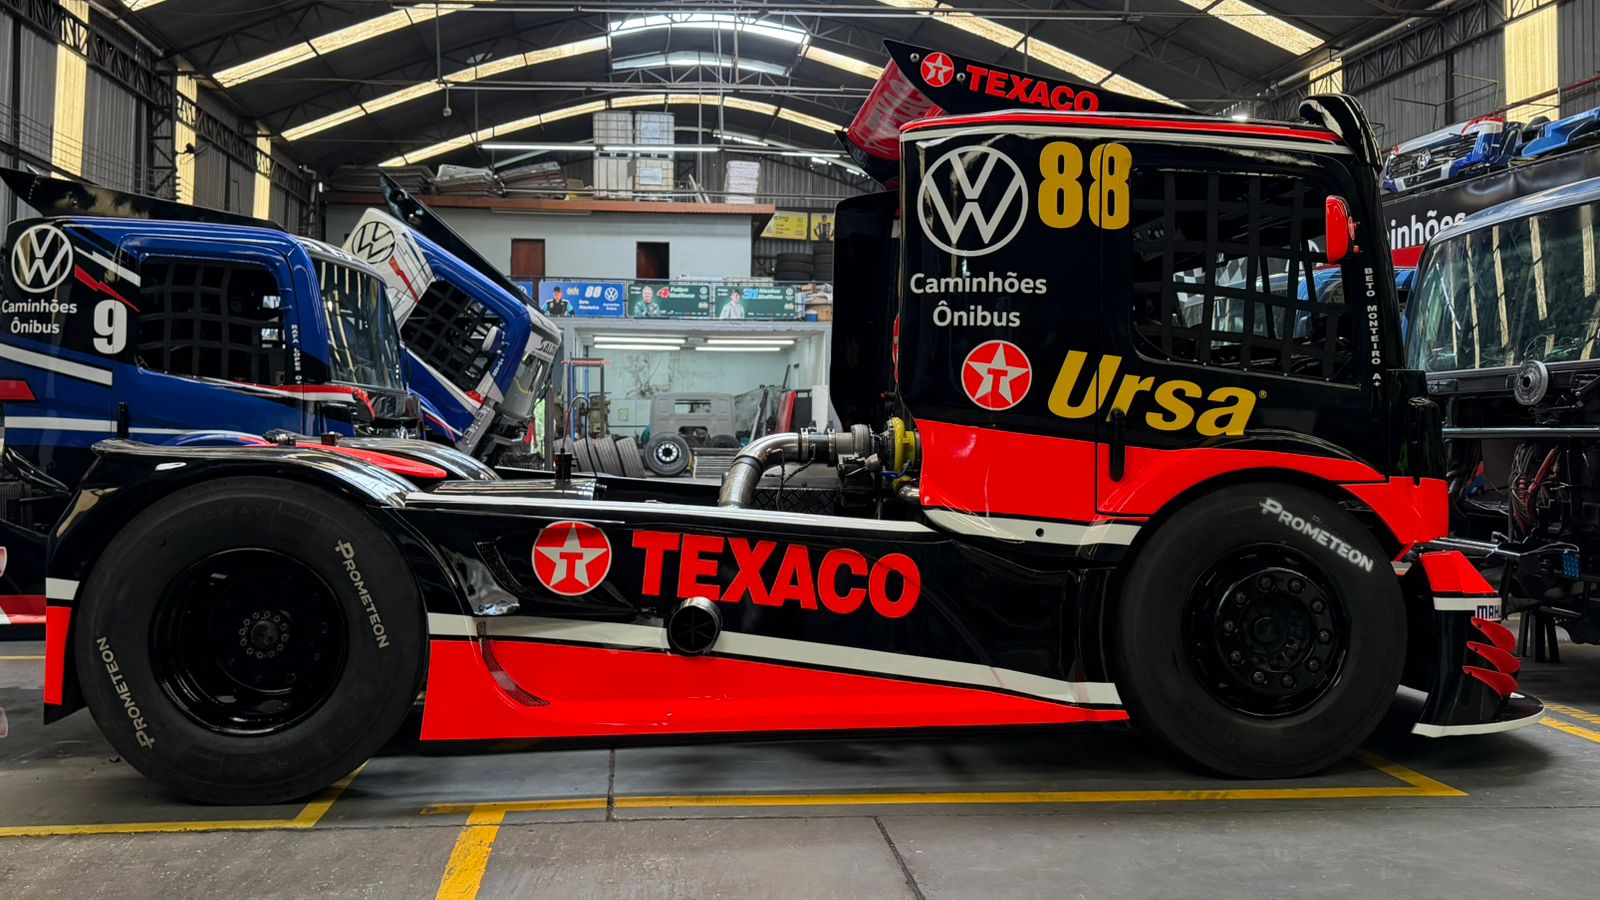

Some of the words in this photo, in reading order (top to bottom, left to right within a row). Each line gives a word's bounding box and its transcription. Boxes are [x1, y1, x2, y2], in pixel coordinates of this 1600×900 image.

[966, 64, 1099, 112] TEXACO
[1038, 141, 1133, 230] 88
[1390, 210, 1466, 250] inhõe
[2, 299, 78, 314] Caminhões
[585, 286, 602, 298] 88
[910, 271, 1047, 294] Caminhões
[1364, 267, 1375, 297] BETO
[11, 316, 60, 334] Ônibus
[93, 299, 127, 355] 9
[933, 300, 1021, 327] Ônibus
[1366, 305, 1381, 365] MONTEIRO
[1048, 350, 1257, 436] Ursa
[1260, 497, 1375, 573] PROMETEON
[335, 538, 390, 649] PROMETEON
[631, 529, 921, 619] TEXACO
[96, 636, 157, 750] PROMETEON
